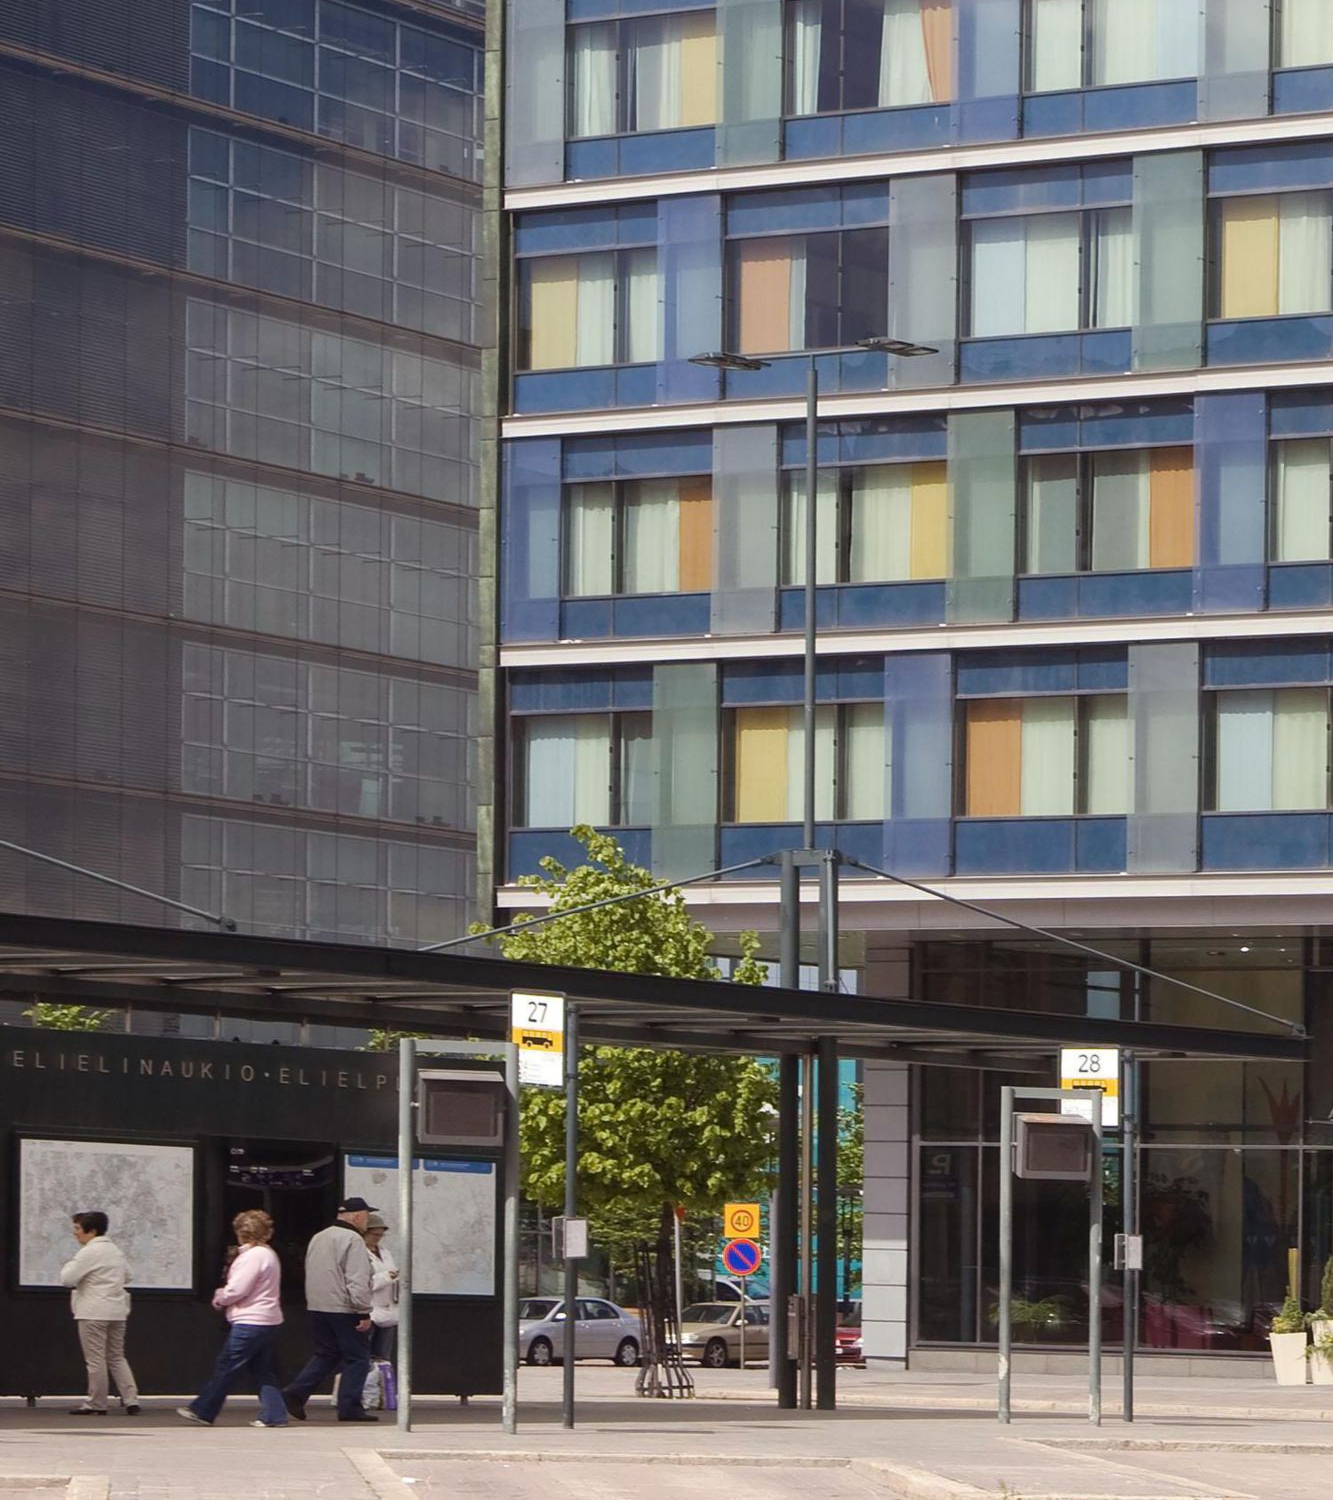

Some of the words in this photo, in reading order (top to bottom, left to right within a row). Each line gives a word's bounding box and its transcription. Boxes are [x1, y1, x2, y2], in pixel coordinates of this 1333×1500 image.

[528, 1001, 548, 1023] 27
[1078, 1054, 1101, 1073] 28
[734, 1215, 750, 1227] 40
